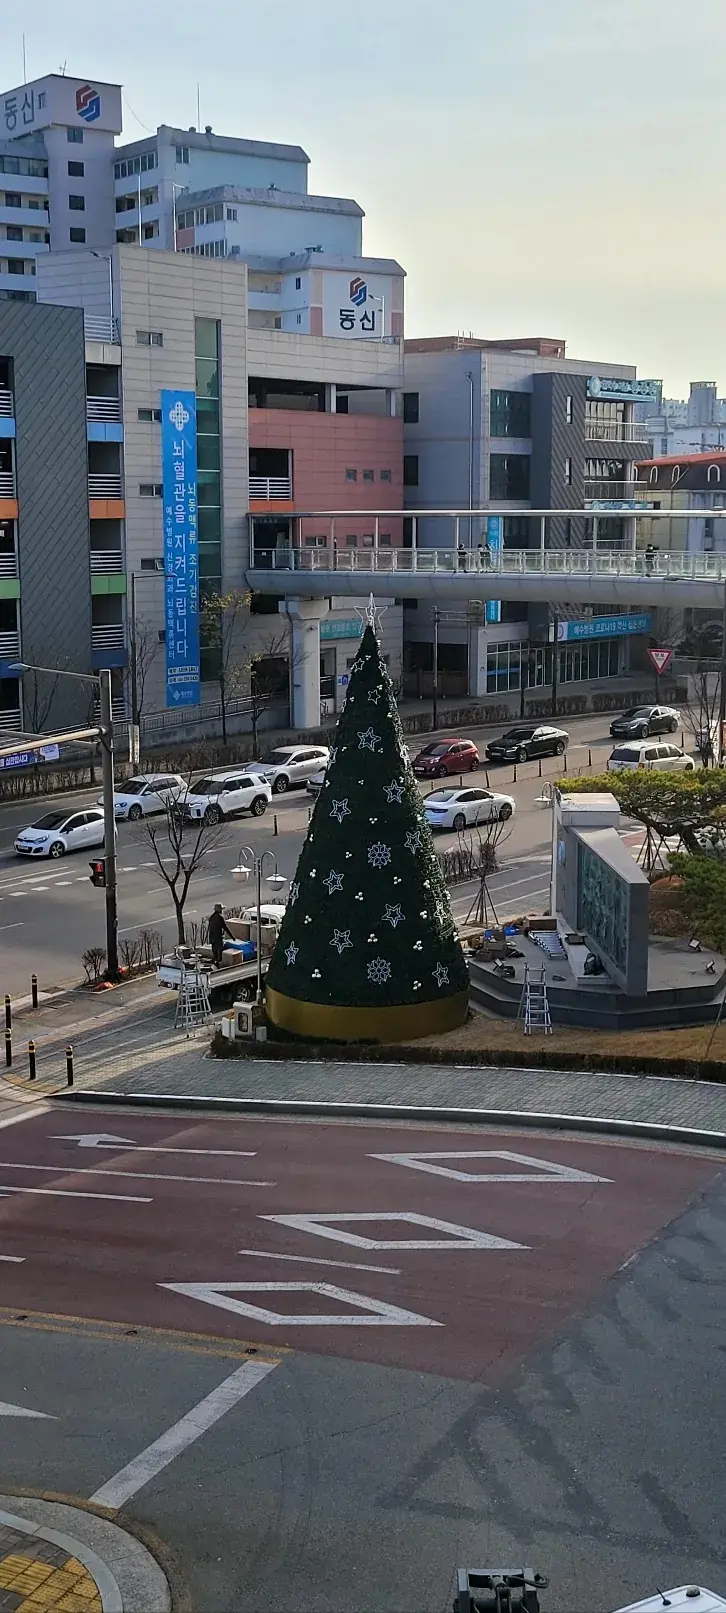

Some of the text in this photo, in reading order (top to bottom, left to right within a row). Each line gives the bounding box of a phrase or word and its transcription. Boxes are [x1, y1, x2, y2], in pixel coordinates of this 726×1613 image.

[4, 89, 34, 130] 동신
[340, 309, 374, 331] 동신
[173, 439, 185, 523] 뇌혈관을
[188, 482, 198, 614] 뇌동맥류 조기검진
[175, 534, 188, 658] 지켜드립니다
[574, 622, 594, 635] 예수병원
